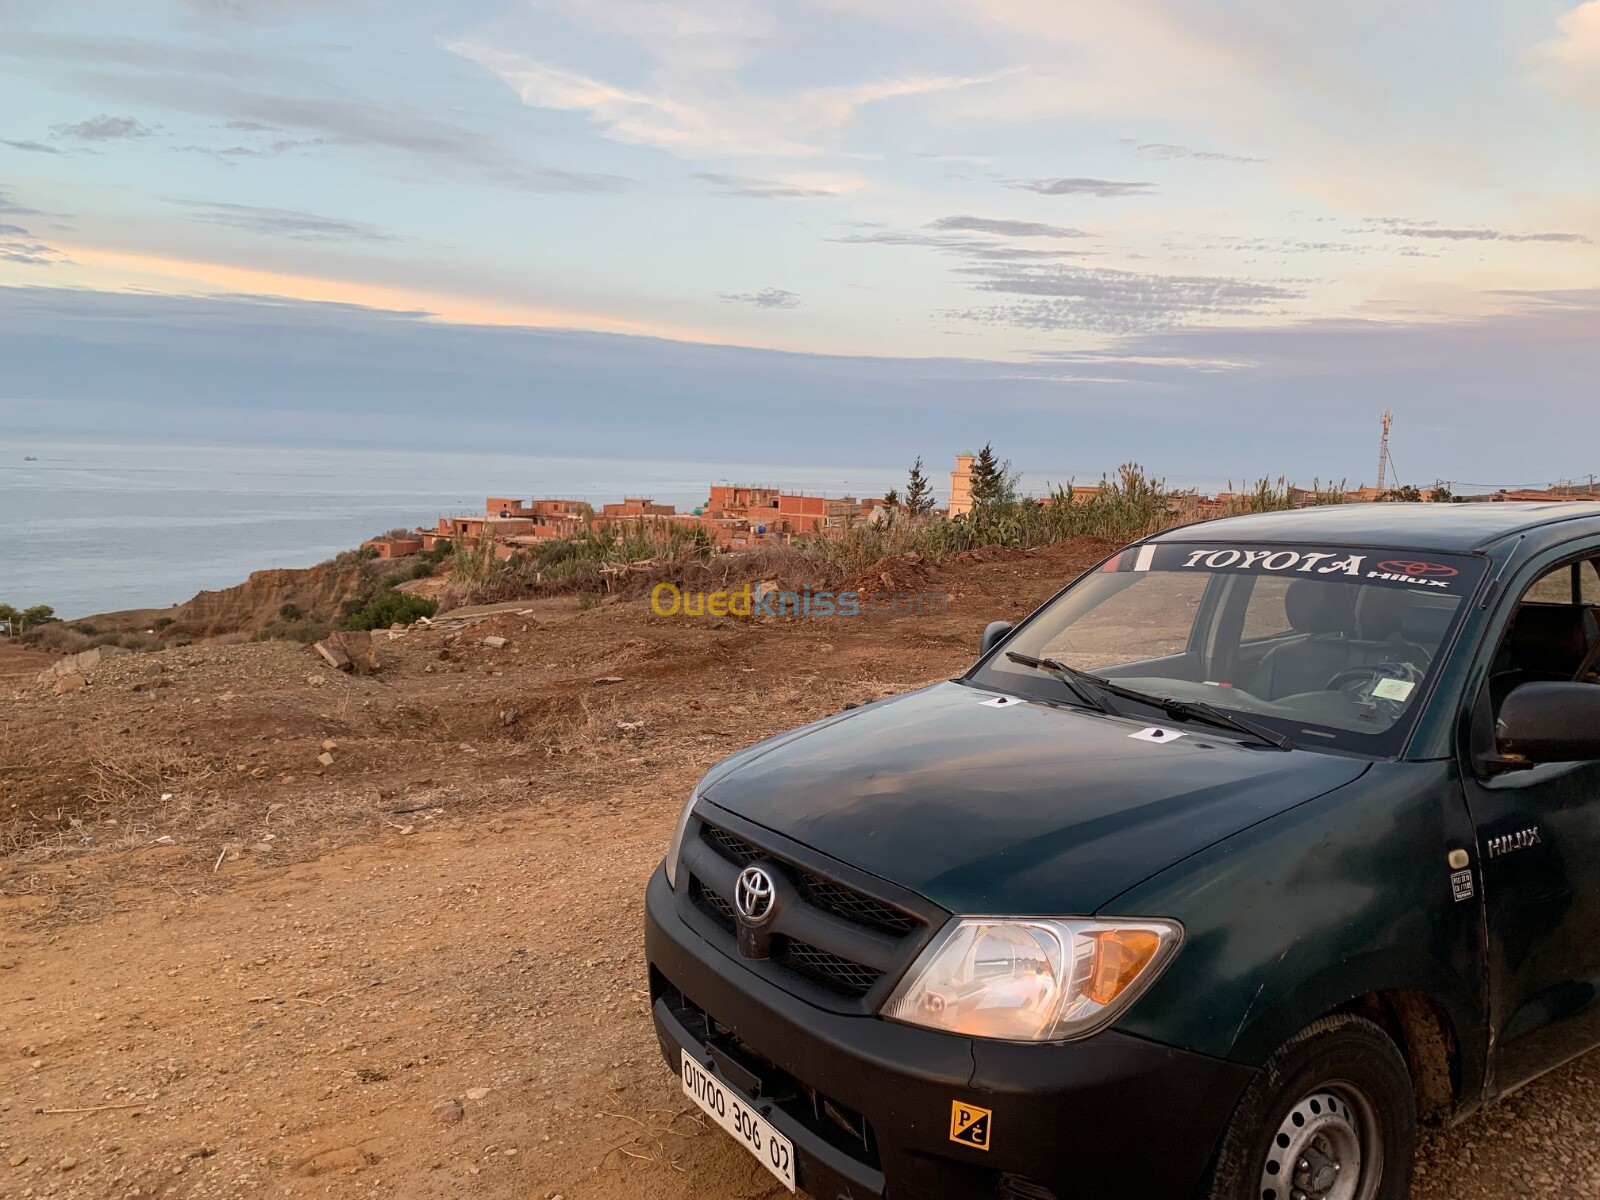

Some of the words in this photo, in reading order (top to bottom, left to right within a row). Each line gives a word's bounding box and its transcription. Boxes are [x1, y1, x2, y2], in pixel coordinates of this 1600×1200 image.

[1182, 549, 1367, 576] TOYOTA
[1487, 826, 1541, 858] HILUX
[684, 1060, 725, 1118] 011700
[733, 1102, 761, 1151] 306
[770, 1136, 790, 1180] 02
[958, 1109, 971, 1127] P
